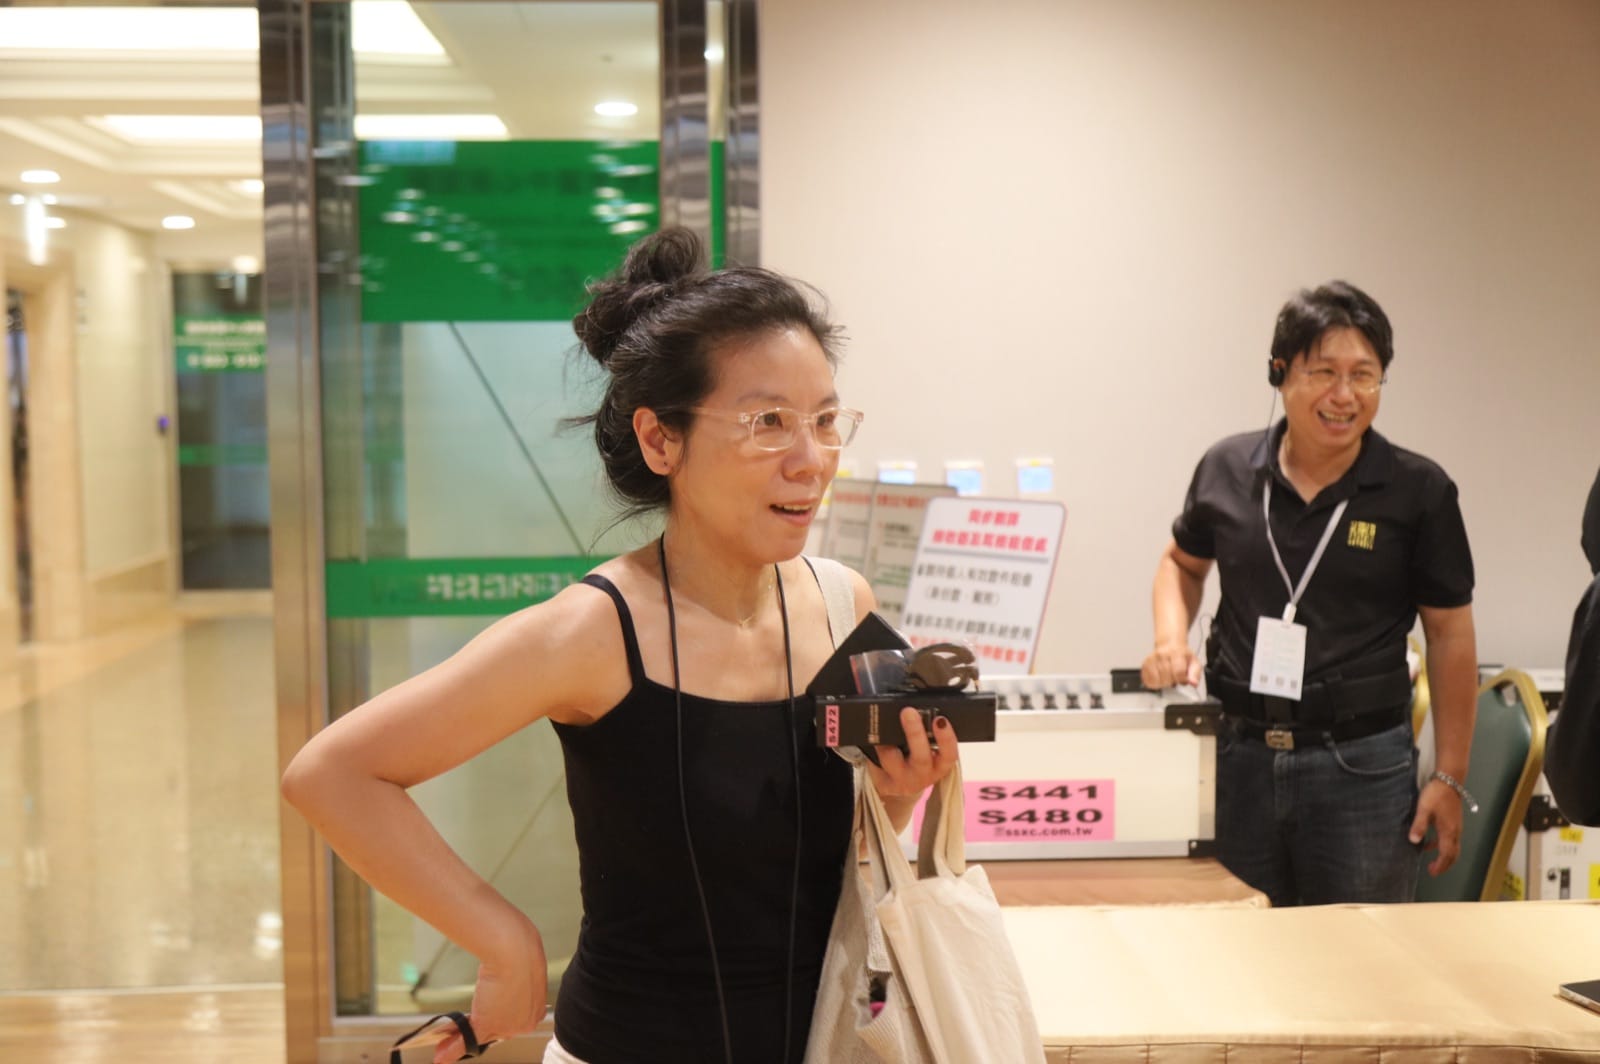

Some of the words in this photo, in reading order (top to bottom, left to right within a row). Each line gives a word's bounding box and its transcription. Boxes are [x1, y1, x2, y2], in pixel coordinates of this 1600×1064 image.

[828, 708, 837, 744] S472
[978, 785, 1099, 801] S441
[978, 808, 1103, 825] S480
